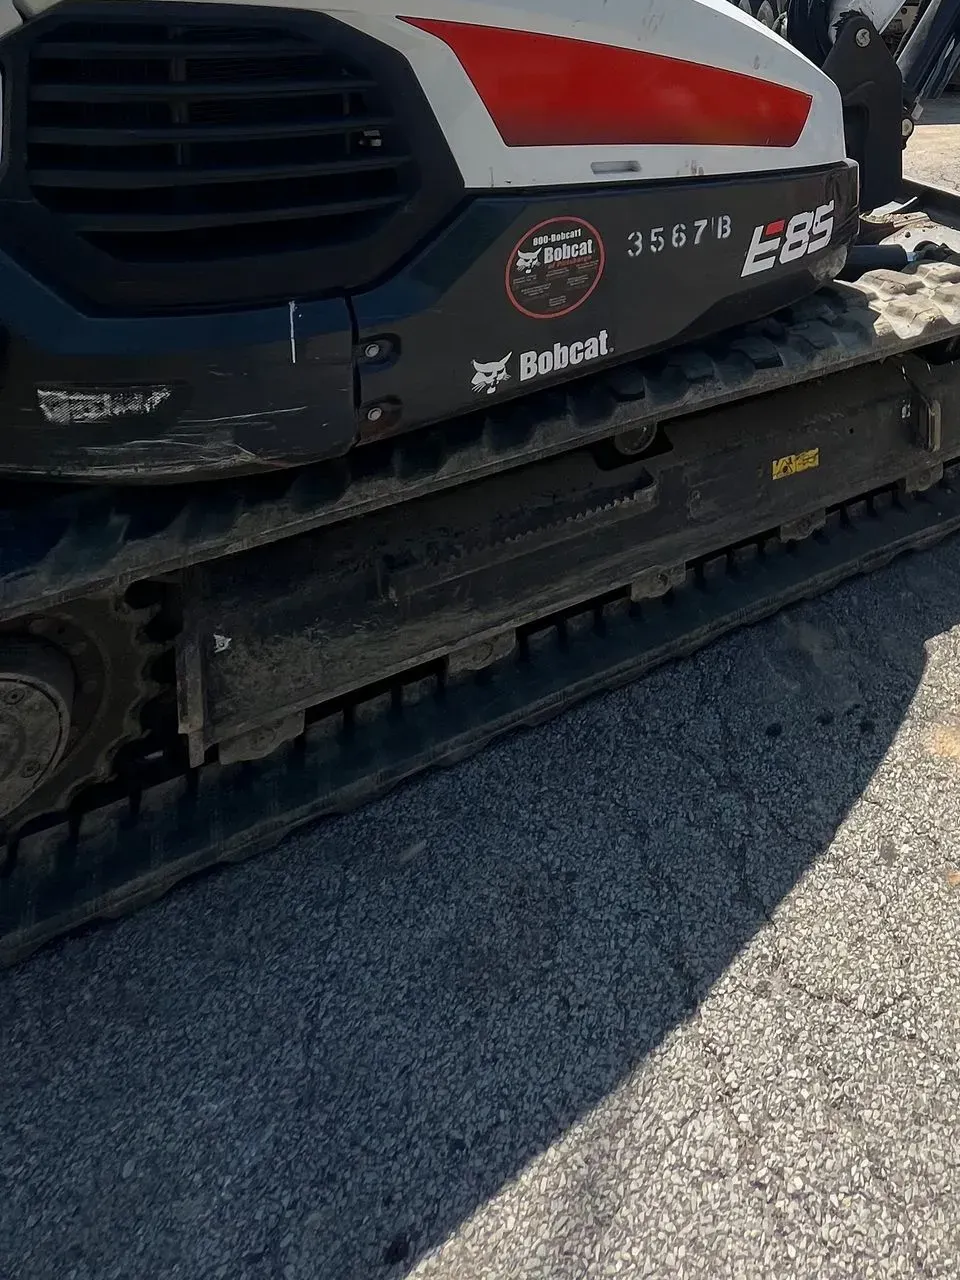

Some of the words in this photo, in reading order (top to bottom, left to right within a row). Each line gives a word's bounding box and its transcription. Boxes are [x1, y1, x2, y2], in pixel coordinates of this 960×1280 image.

[544, 239, 593, 264] Bobcat
[741, 199, 835, 278] E85
[520, 329, 608, 382] Bobcat
